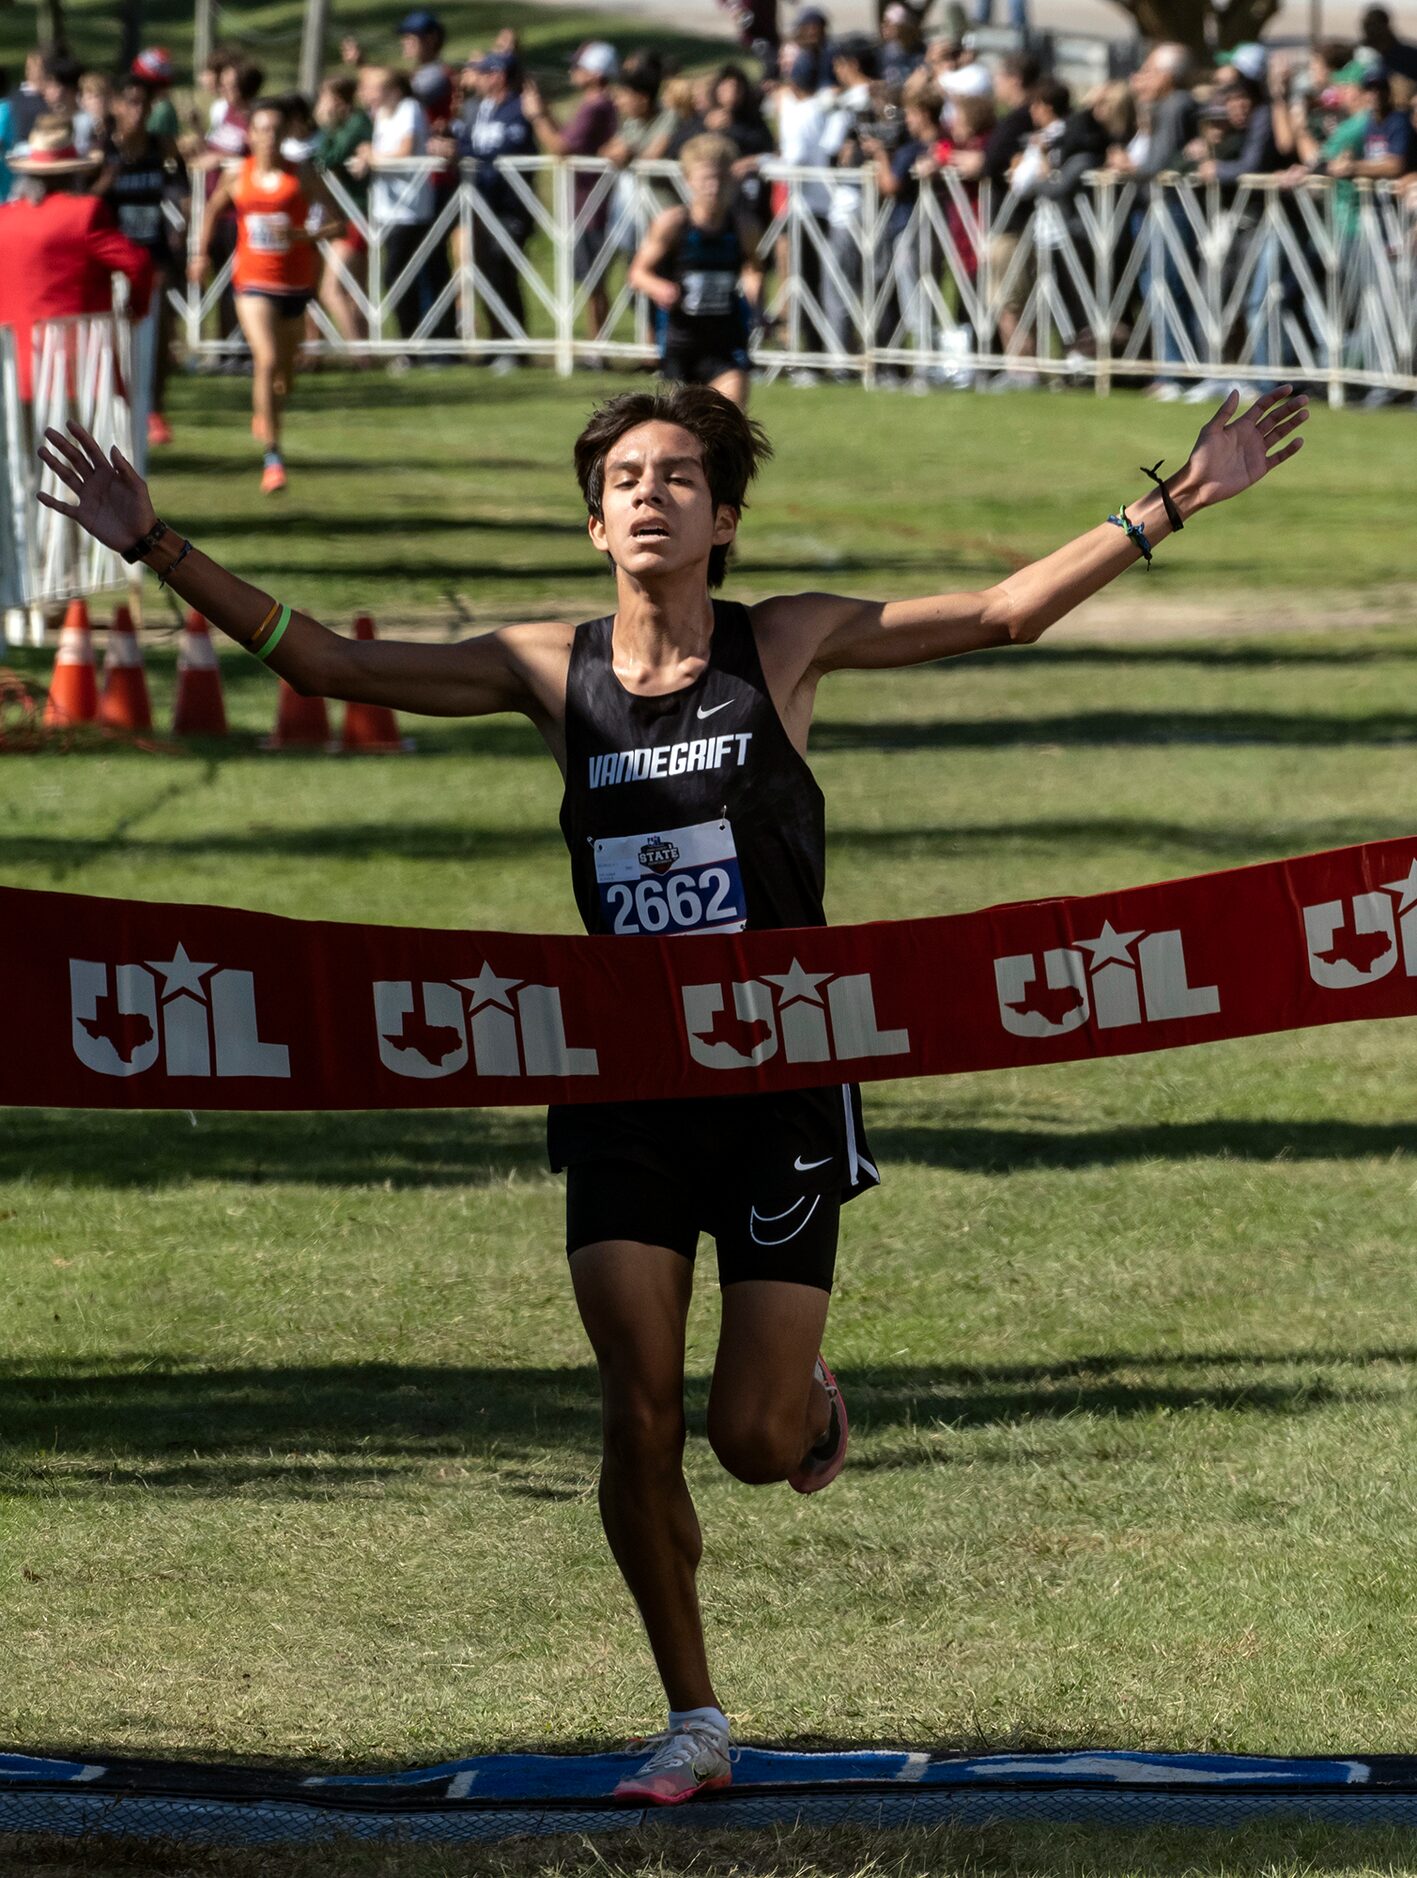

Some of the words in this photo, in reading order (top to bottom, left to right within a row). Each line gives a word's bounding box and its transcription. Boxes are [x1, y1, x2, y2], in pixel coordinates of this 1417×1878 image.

[589, 733, 752, 789] VANDEGRIFT
[639, 848, 679, 862] STATE
[606, 867, 738, 935] 2662
